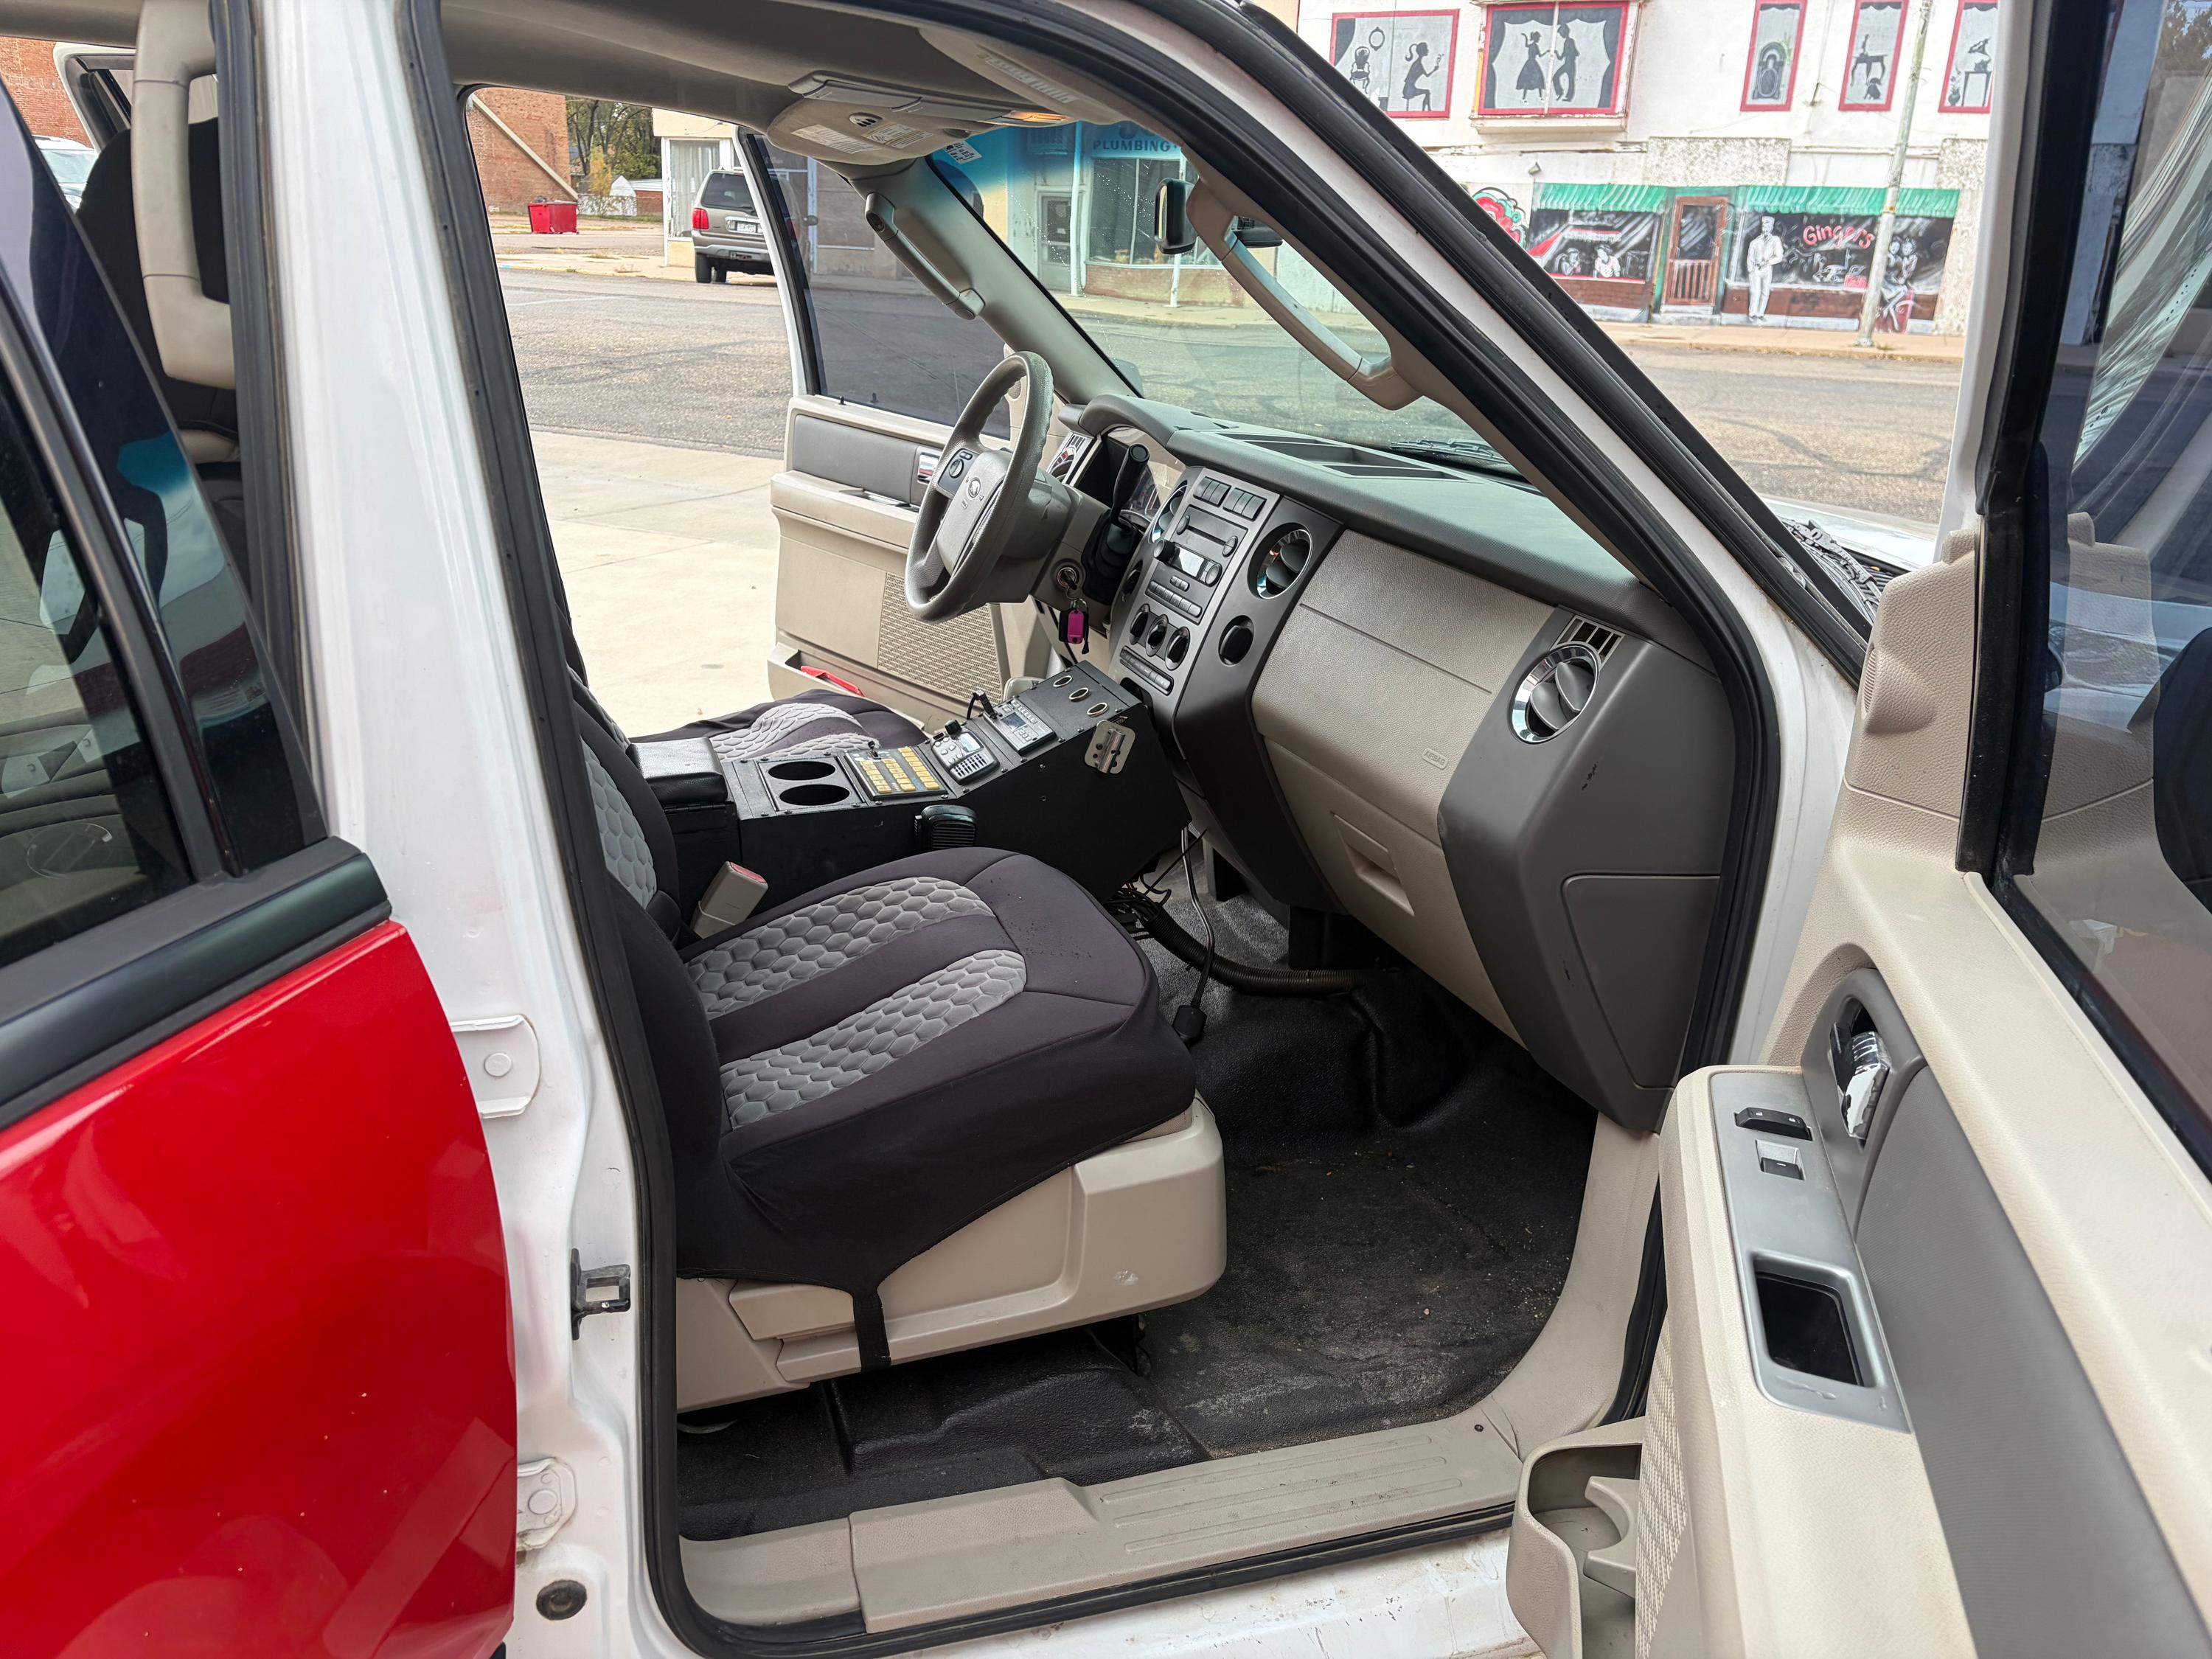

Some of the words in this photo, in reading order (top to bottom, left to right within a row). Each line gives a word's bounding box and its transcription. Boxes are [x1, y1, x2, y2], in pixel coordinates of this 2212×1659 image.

[1093, 140, 1171, 152] PLUMBING
[1803, 225, 1875, 248] Gingers
[1424, 751, 1445, 765] AIRBAG
